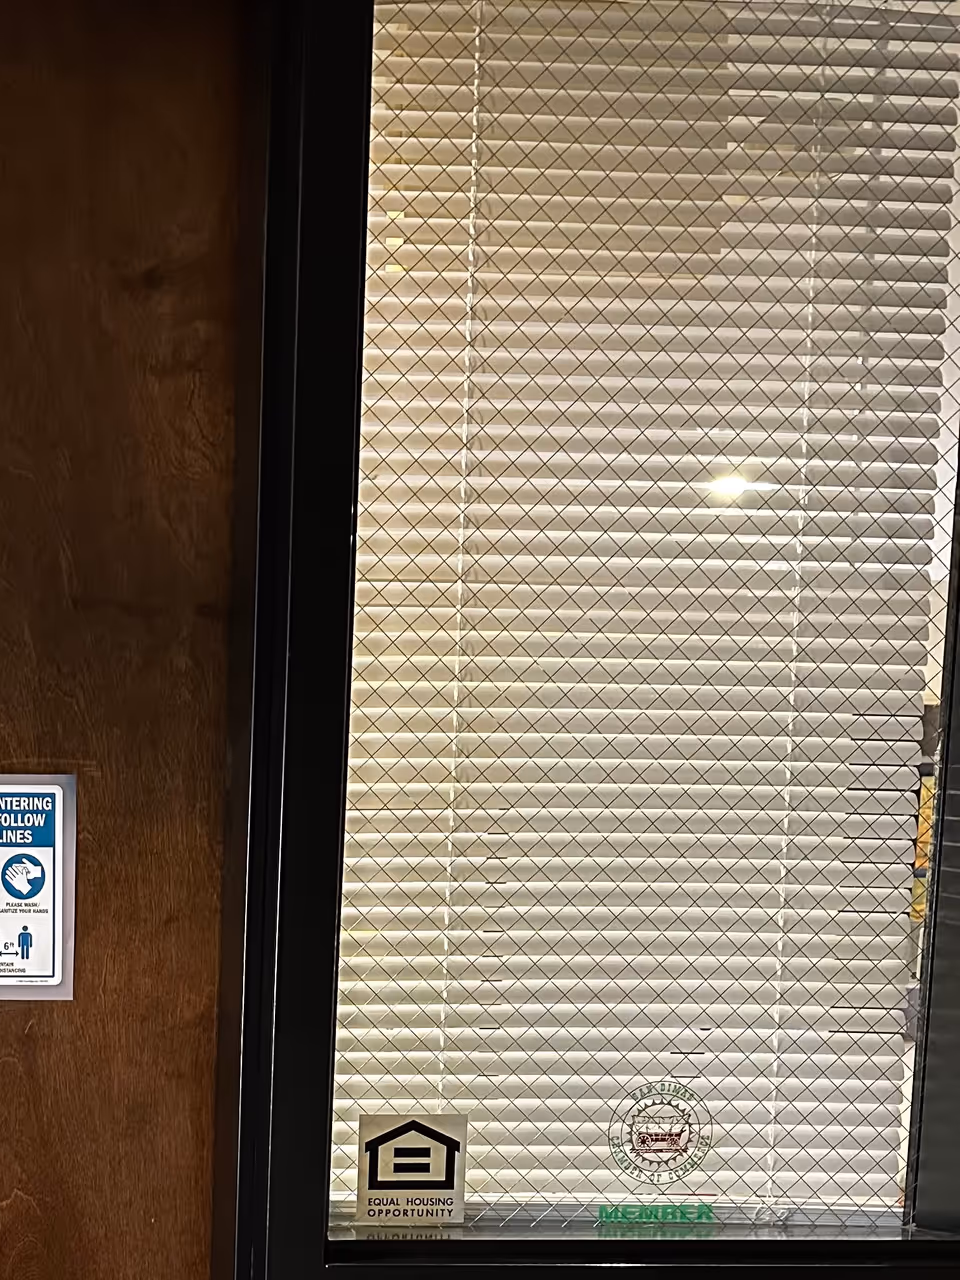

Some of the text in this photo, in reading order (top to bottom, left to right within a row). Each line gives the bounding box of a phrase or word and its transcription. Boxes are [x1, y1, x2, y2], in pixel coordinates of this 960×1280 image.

[367, 1197, 454, 1206] EQUAL HOUSING
[367, 1208, 454, 1218] OPPORTUNITY
[598, 1204, 714, 1223] MEMBER
